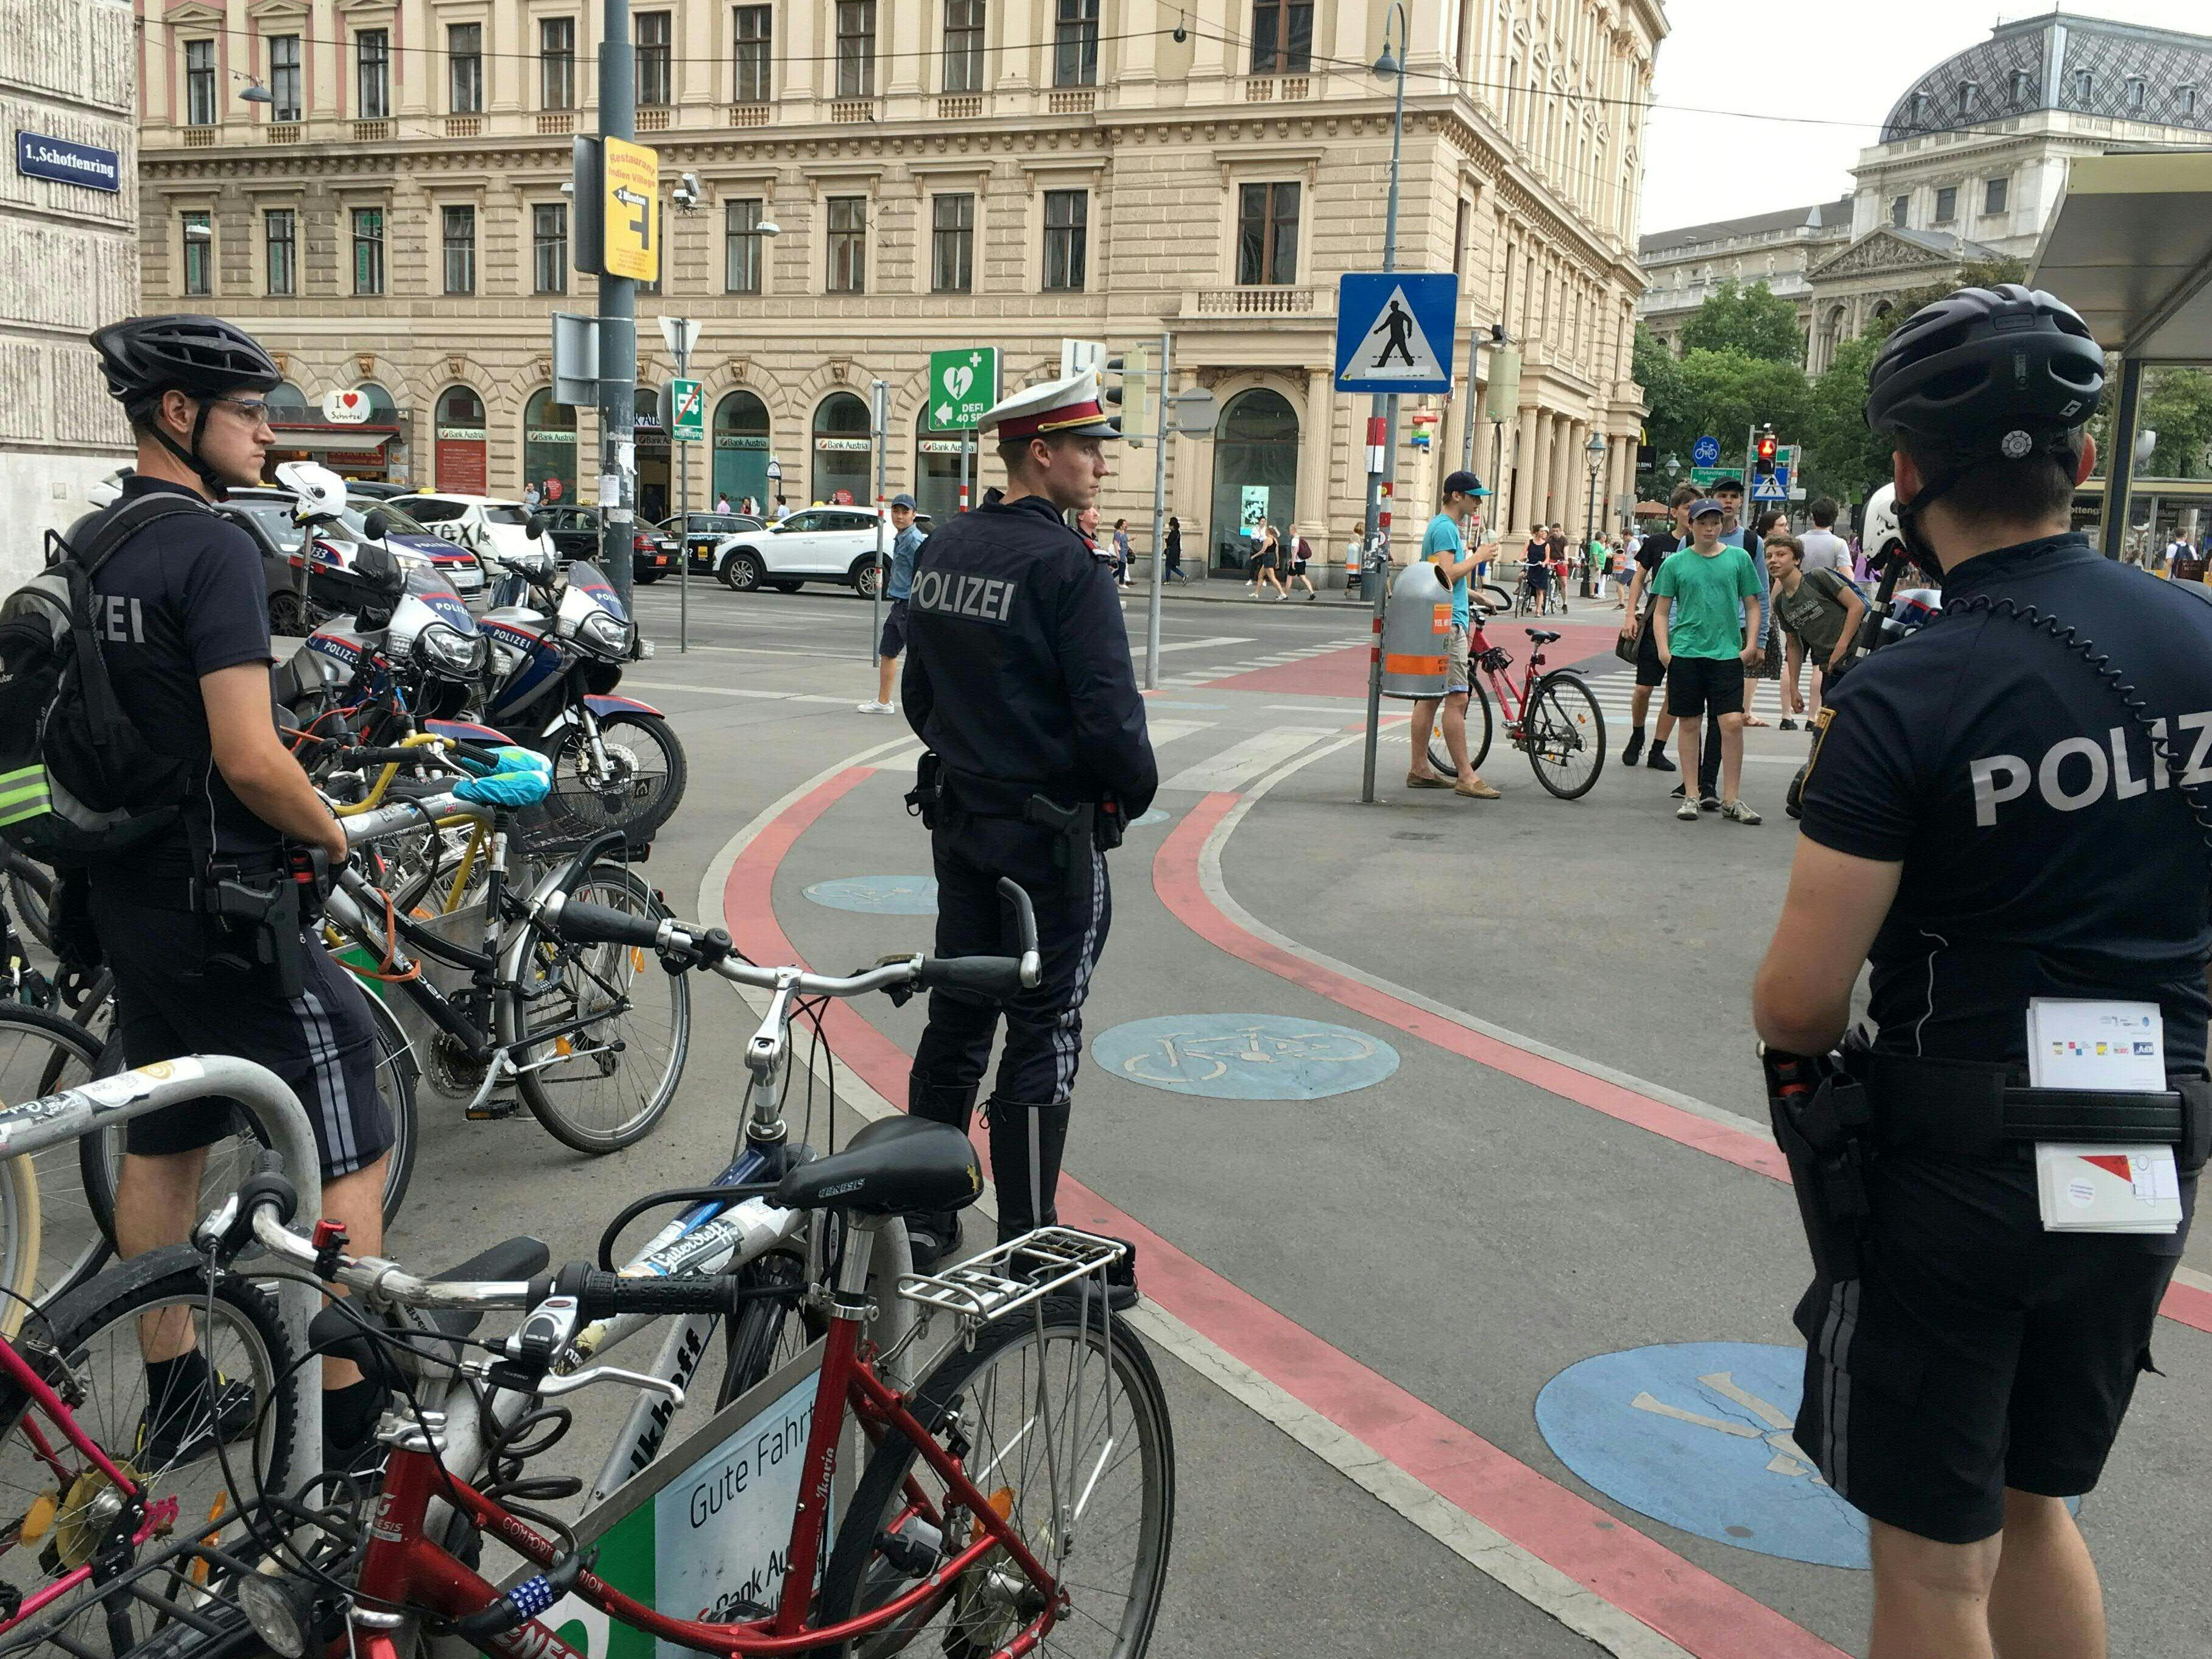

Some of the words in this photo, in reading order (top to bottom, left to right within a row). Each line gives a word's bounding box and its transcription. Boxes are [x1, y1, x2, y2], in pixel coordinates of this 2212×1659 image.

[610, 153, 655, 177] Restaurant
[608, 167, 630, 180] Indien
[633, 173, 656, 188] Village
[618, 189, 622, 200] 2
[623, 191, 646, 205] Minuten
[335, 396, 340, 409] I
[962, 403, 984, 413] DEFI
[331, 411, 362, 420] Schnitzel
[956, 414, 969, 423] 40
[970, 414, 984, 423] SE
[465, 430, 484, 439] Austria
[554, 433, 575, 442] Austria
[728, 439, 744, 447] Bank
[828, 441, 844, 449] Bank
[845, 442, 868, 450] Austria
[950, 443, 974, 453] Ausa
[312, 546, 328, 558] 133
[908, 570, 1015, 621] POLIZEI
[493, 629, 531, 649] POLIZEI
[1970, 712, 2212, 826] POLIZ
[818, 1178, 865, 1198] GENESIS
[690, 1459, 748, 1529] Gute
[758, 1406, 815, 1478] Fahrt
[503, 1516, 554, 1552] COMFORT
